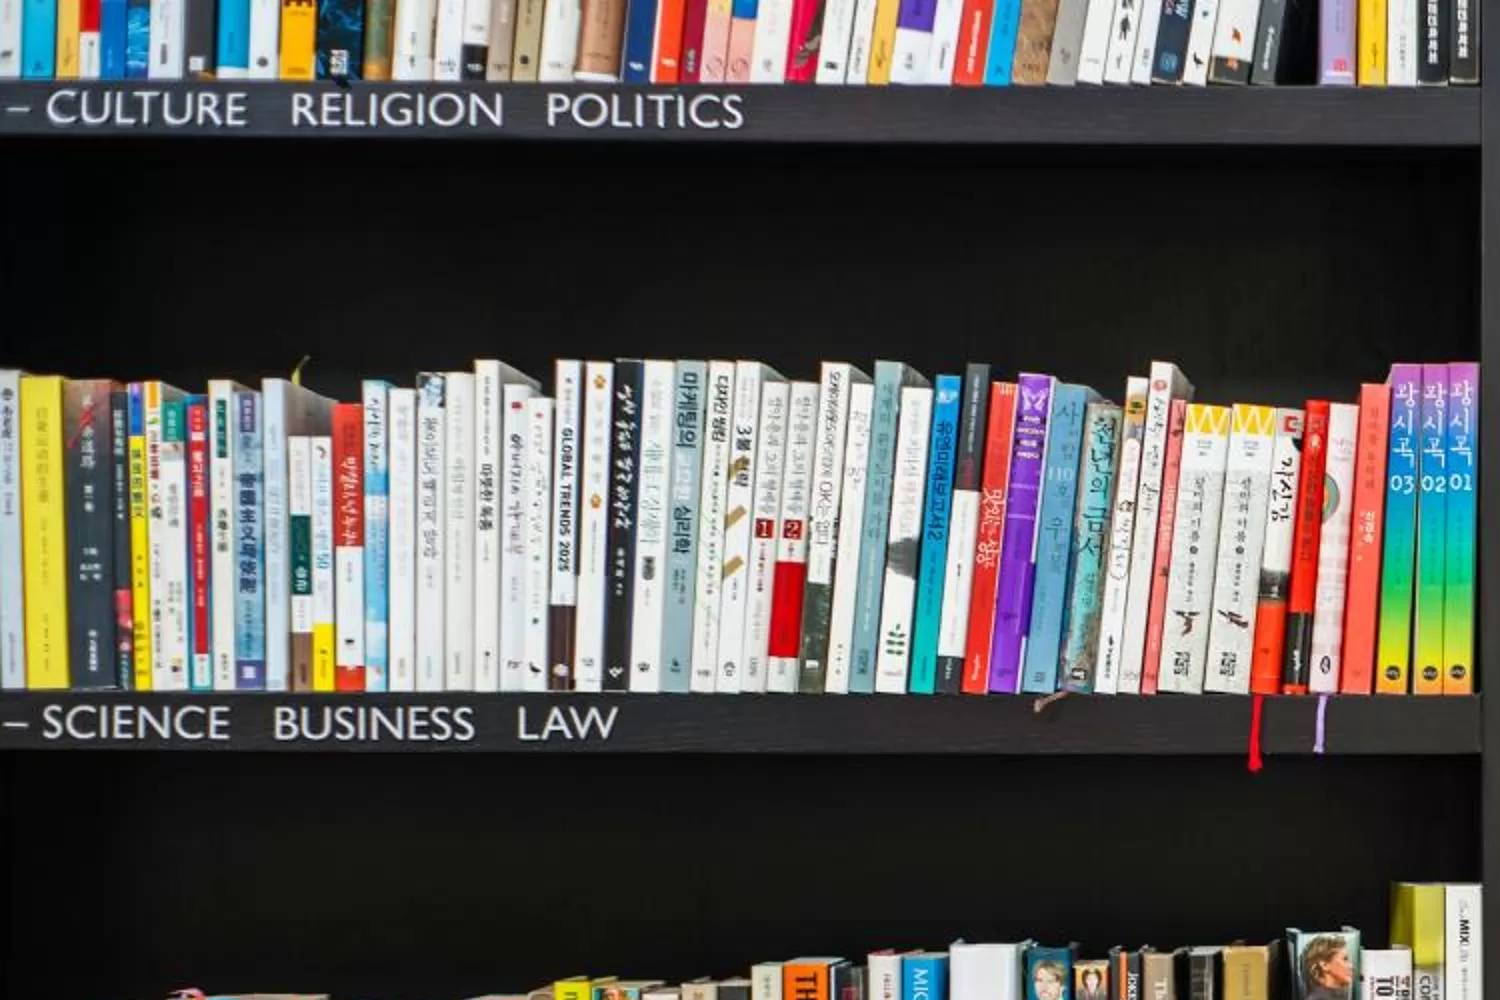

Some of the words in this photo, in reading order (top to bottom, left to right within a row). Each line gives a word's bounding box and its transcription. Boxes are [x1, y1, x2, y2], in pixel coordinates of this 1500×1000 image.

[47, 91, 246, 126] CULTURE
[292, 93, 502, 128] RELIGION
[547, 94, 743, 129] POLITICS
[676, 372, 698, 448] 마케팅의
[715, 375, 728, 415] 디자인
[560, 428, 572, 479] GLOBAL
[927, 421, 953, 541] 유엔미래보고서2
[1391, 475, 1414, 494] 03
[1422, 476, 1446, 493] 02
[1450, 474, 1473, 491] 01
[559, 484, 571, 536] TRENDS
[672, 507, 692, 554] 심리학
[558, 541, 571, 571] 2025
[42, 705, 229, 741] SCIENCE
[275, 706, 474, 741] BUSINESS
[518, 707, 618, 740] LAW
[1460, 918, 1470, 943] MIX
[1375, 976, 1394, 997] TO
